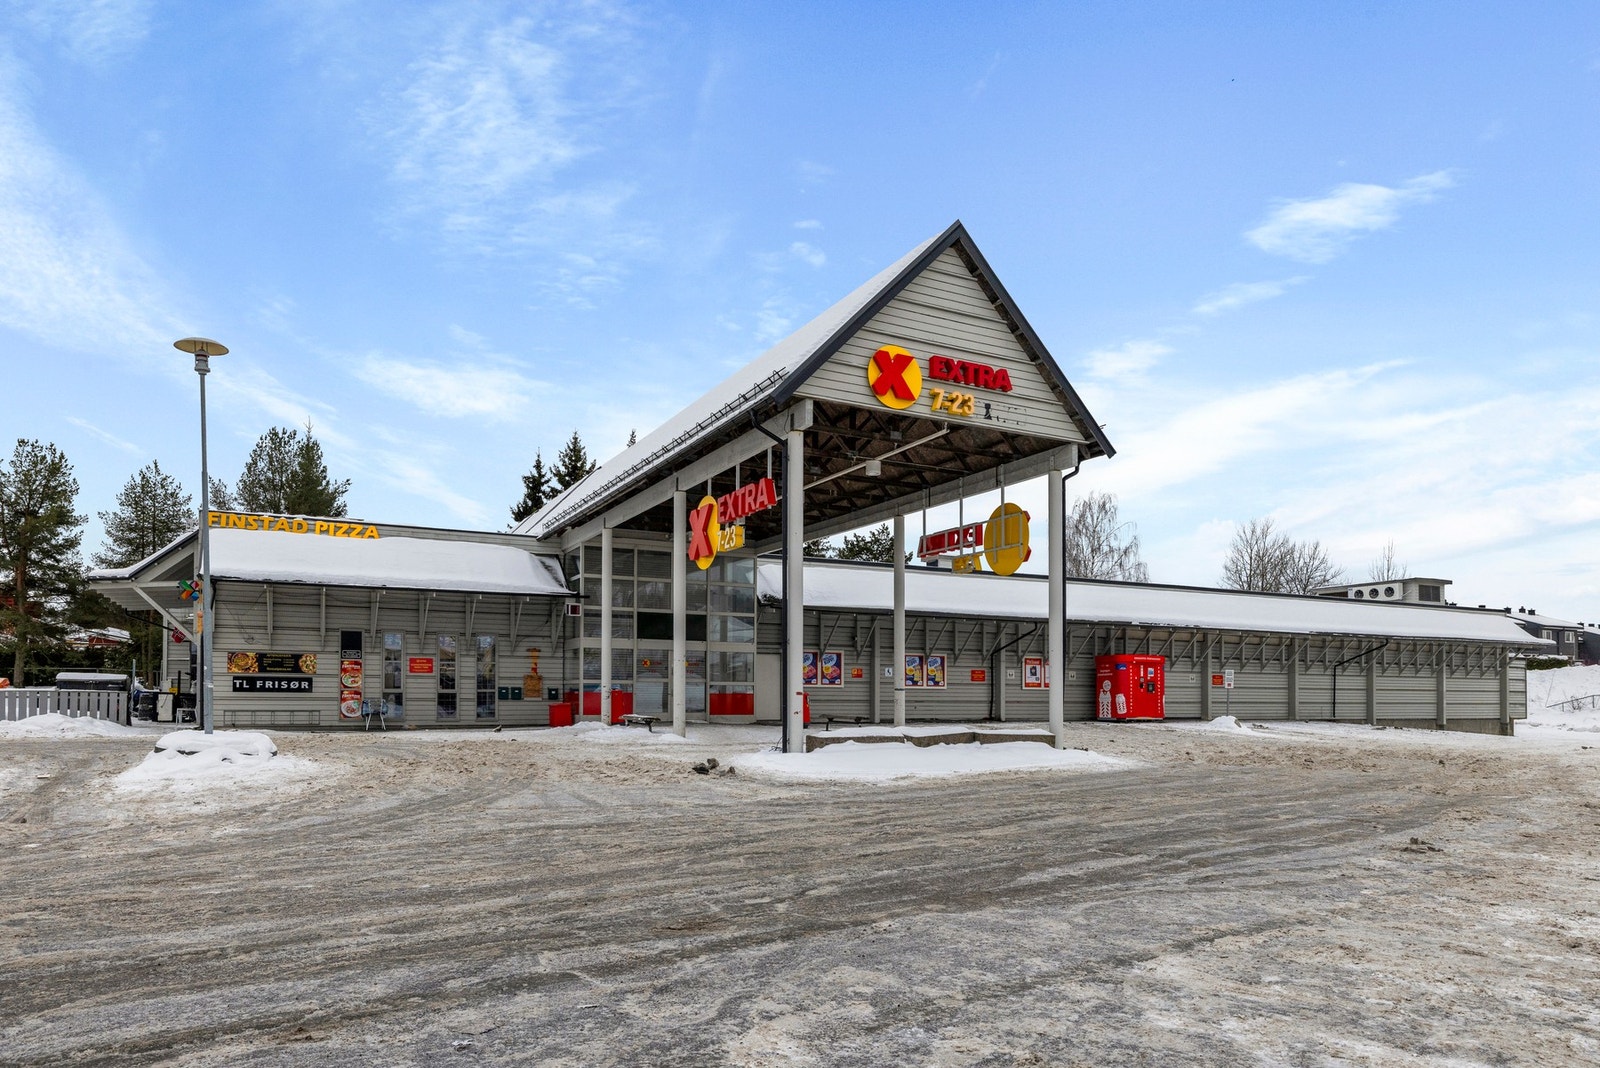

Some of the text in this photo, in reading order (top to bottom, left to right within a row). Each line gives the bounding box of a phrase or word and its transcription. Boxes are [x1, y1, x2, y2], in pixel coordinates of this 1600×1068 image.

[872, 350, 916, 401] X
[929, 355, 1013, 393] EXTRA
[930, 387, 975, 417] 7-23
[717, 477, 776, 524] EXTRA
[208, 511, 380, 540] FINSTAD PIZZA
[233, 680, 309, 689] TL FRISØR
